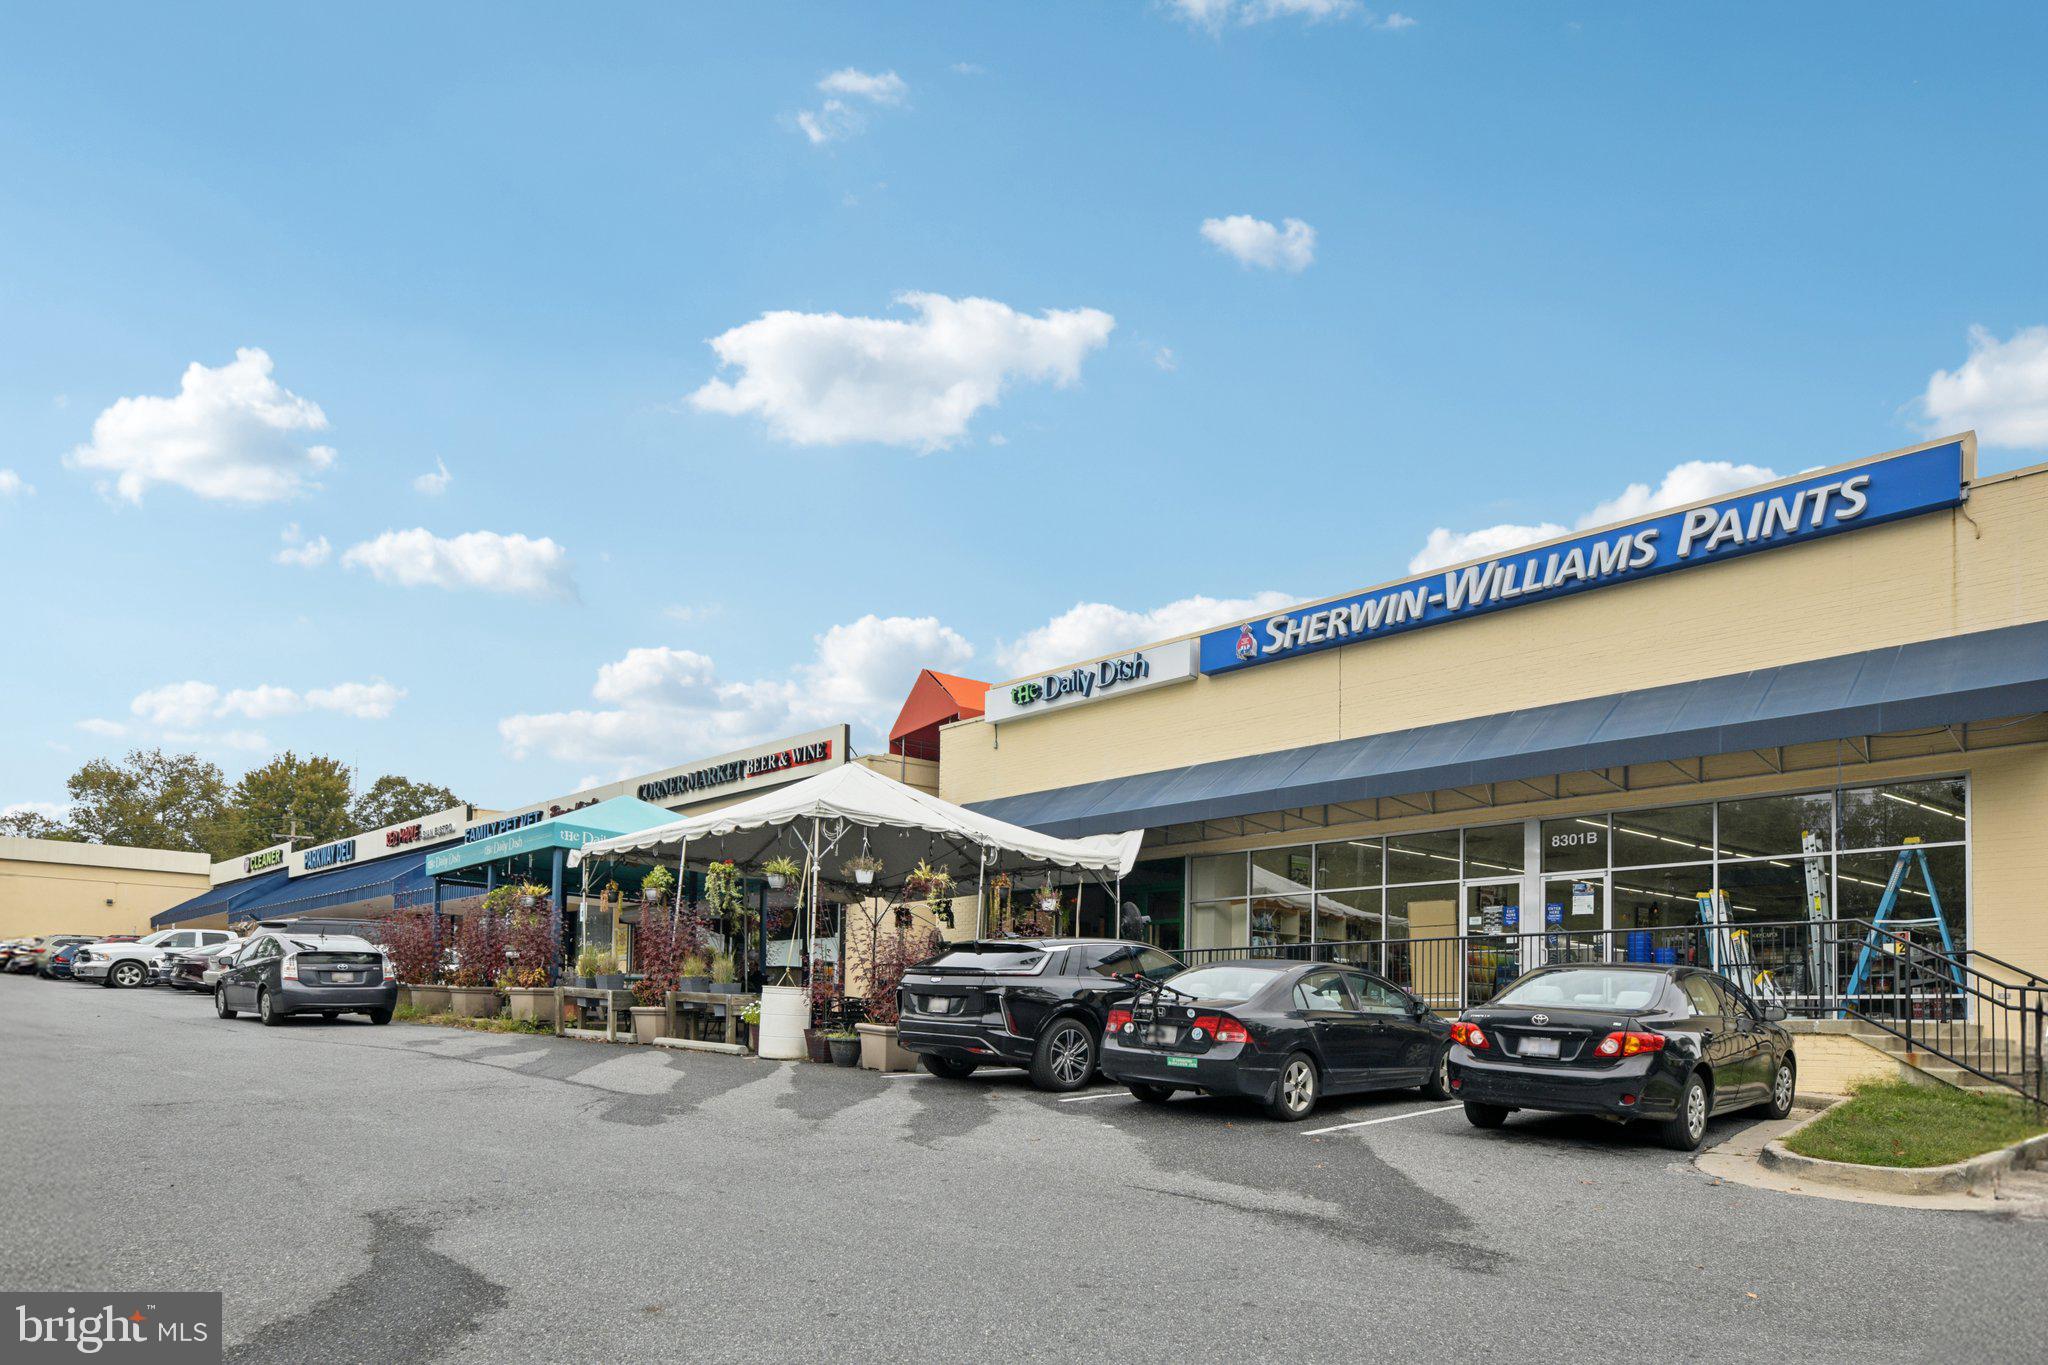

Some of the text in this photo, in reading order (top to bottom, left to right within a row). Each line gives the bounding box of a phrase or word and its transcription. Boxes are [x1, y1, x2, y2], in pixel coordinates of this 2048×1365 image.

[1261, 474, 1870, 655] SHERWIN-WILLIAMS PAINTS
[1041, 668, 1096, 702] Daily
[1095, 652, 1150, 688] Dish
[637, 741, 826, 801] CORNER MARKET BEER & WINE
[464, 811, 543, 843] FAMILY PET VET
[1552, 832, 1597, 847] 8301B
[304, 840, 355, 870] PARKWAY DELI
